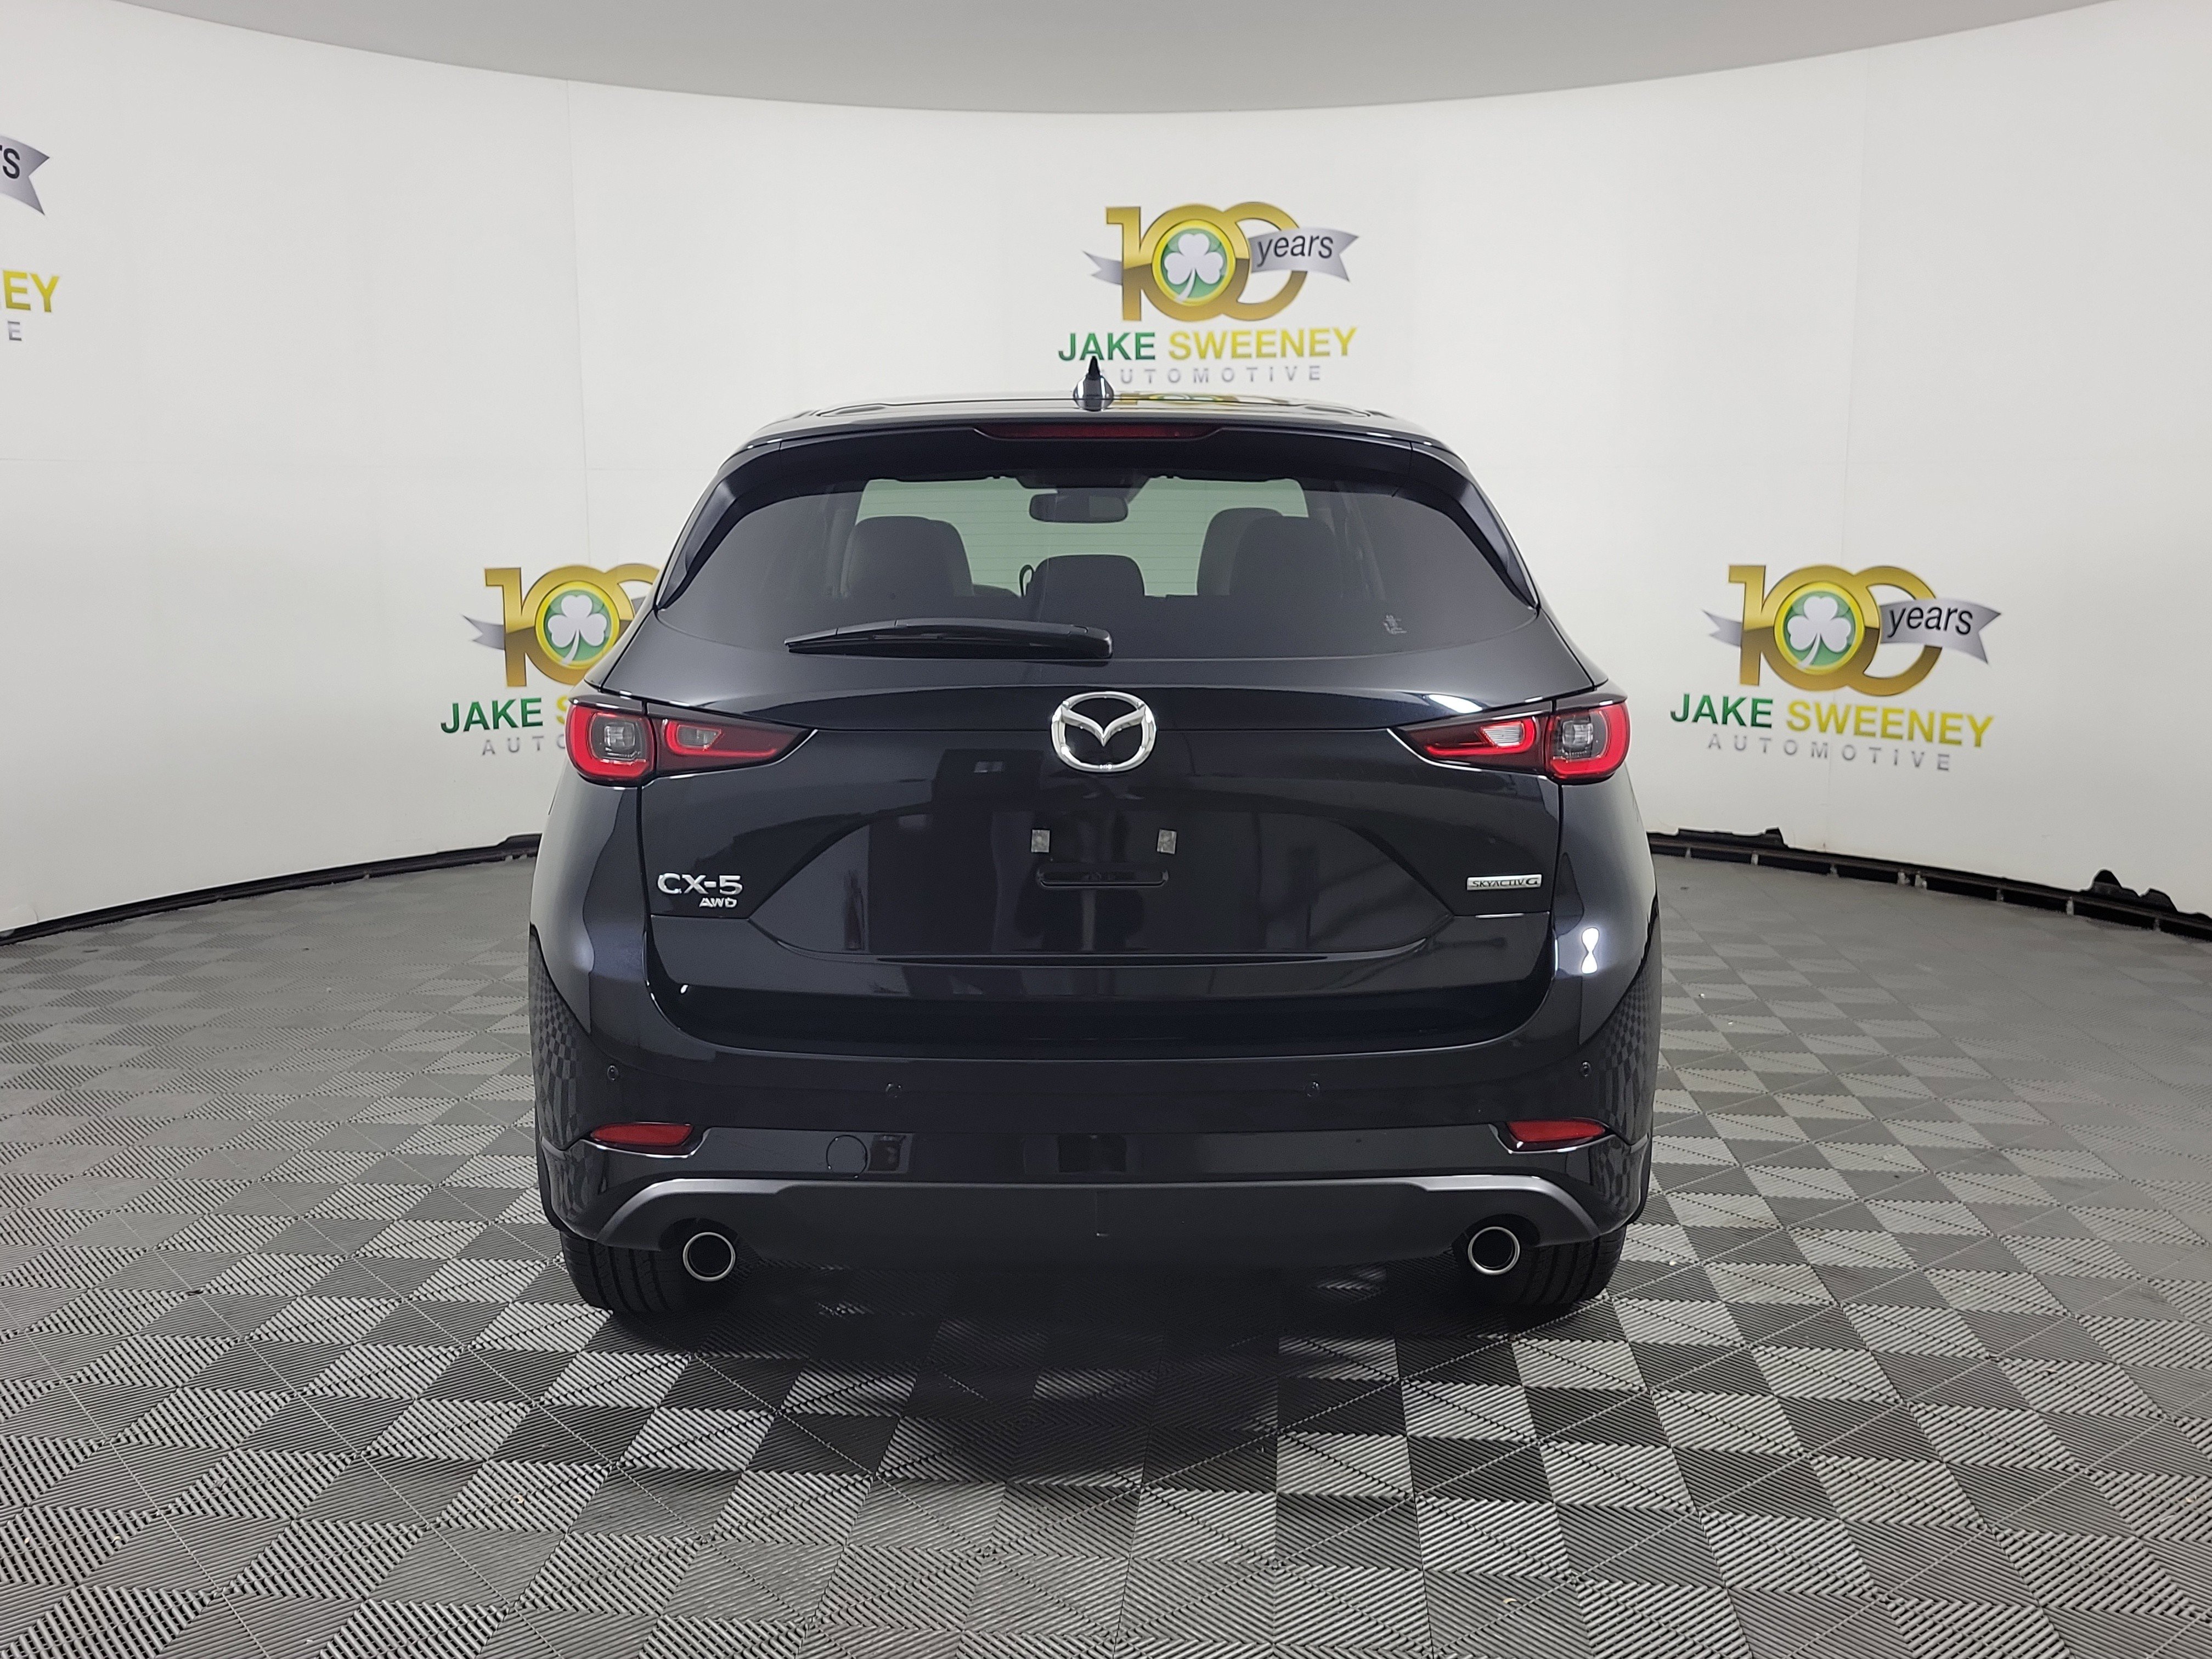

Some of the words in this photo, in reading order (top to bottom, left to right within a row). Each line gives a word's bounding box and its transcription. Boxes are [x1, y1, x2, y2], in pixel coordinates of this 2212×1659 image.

[1106, 201, 1308, 322] 100
[1256, 234, 1334, 267] years
[1058, 332, 1156, 361] JAKE
[1168, 327, 1358, 360] SWEENEY
[1102, 365, 1321, 385] UTOMOTIVE
[1728, 564, 1943, 697] 100
[1887, 606, 1973, 638] years
[441, 697, 544, 734] JAKE
[1670, 693, 1774, 729] JAKE
[1786, 700, 1995, 748] SWEENEY
[1707, 733, 1951, 771] AUTOMOTIVE
[658, 873, 743, 895] CX-5
[698, 897, 737, 908] AWD
